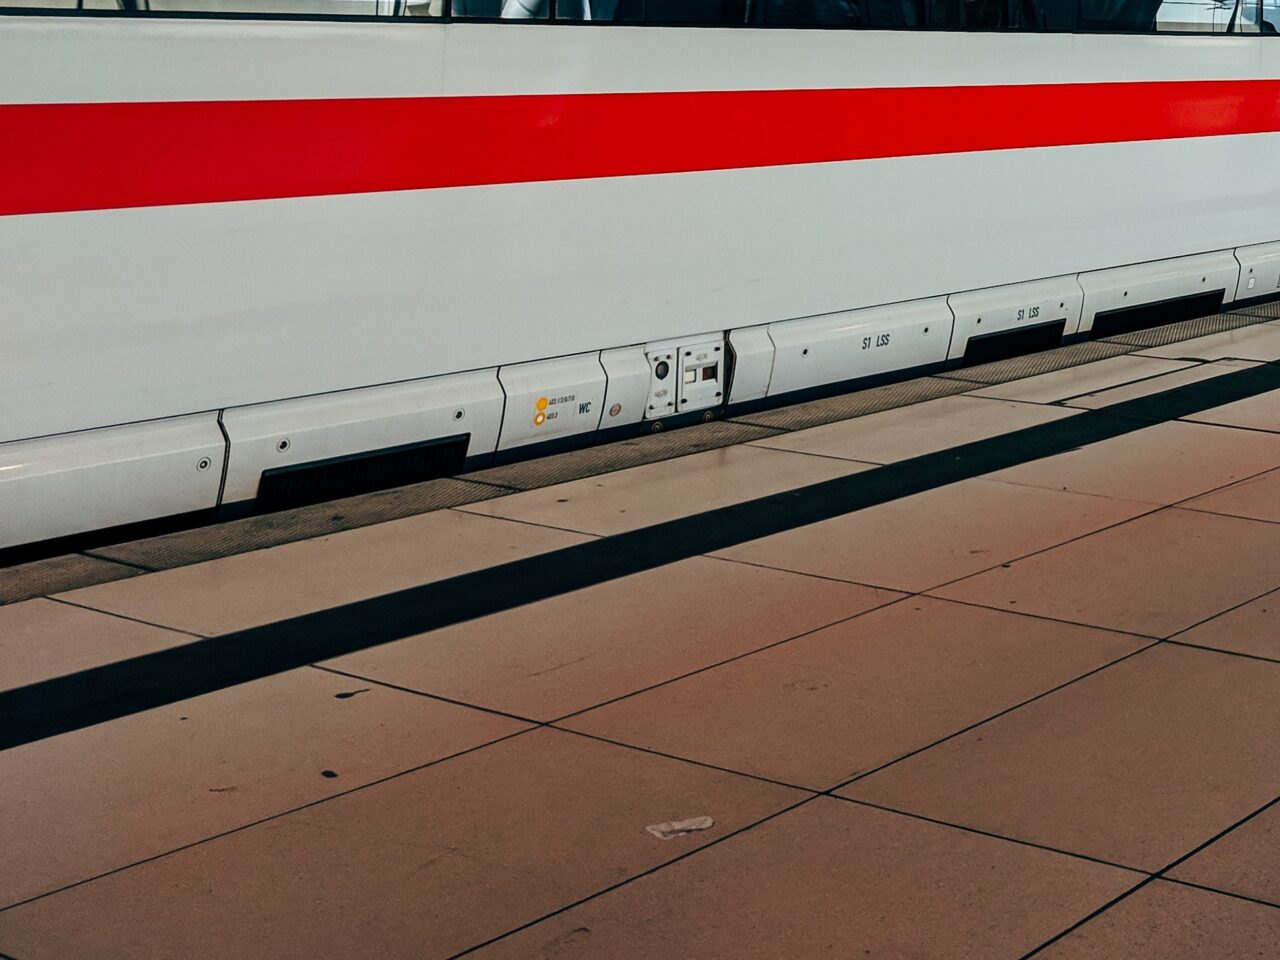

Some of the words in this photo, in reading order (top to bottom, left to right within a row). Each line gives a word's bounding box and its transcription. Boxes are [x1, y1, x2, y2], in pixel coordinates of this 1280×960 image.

[1016, 309, 1025, 321] S1
[1028, 306, 1040, 318] LSS
[861, 336, 871, 350] S1
[876, 333, 890, 347] LSS
[578, 401, 592, 415] WC
